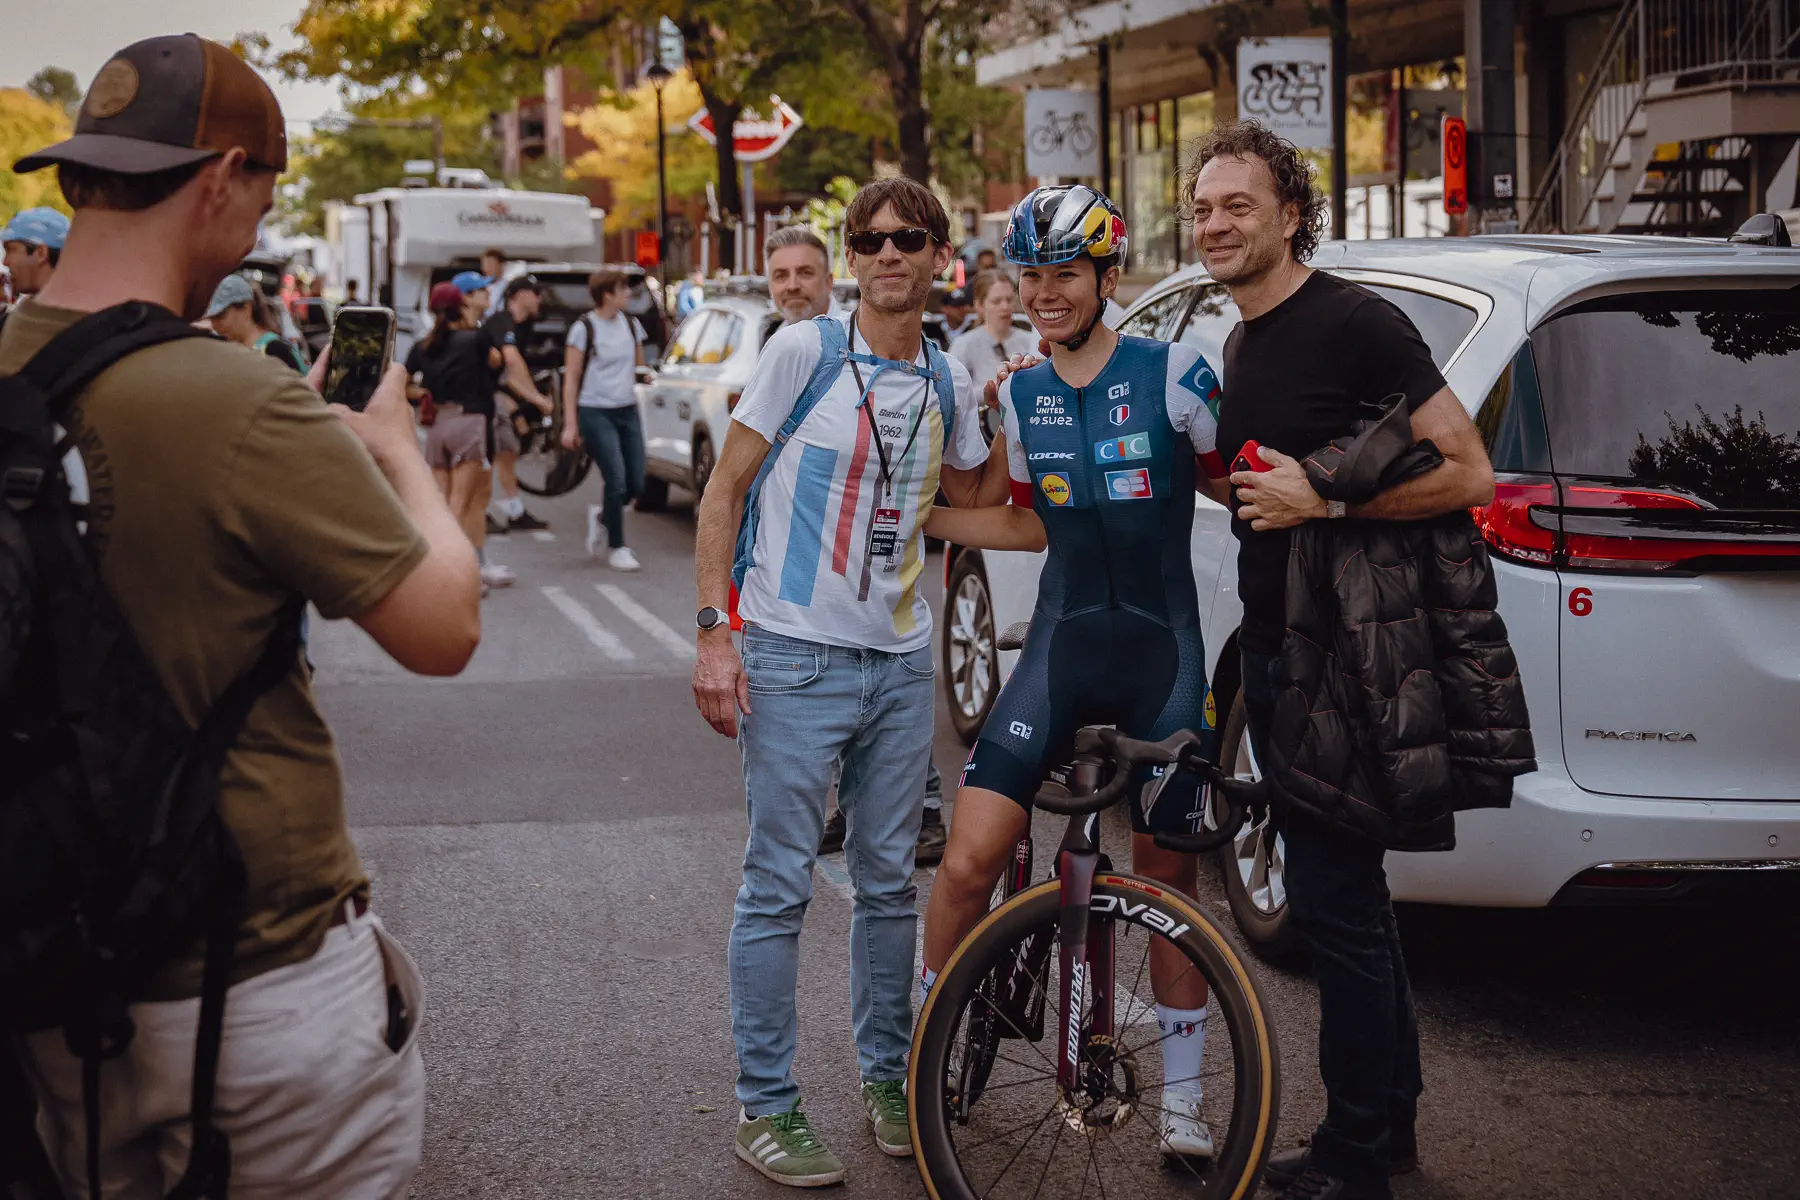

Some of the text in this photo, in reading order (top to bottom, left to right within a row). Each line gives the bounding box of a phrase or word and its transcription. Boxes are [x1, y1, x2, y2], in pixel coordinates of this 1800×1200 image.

[1036, 395, 1056, 407] FDJ
[878, 408, 908, 419] Santini
[879, 424, 903, 439] 1962
[1100, 437, 1146, 459] CIC
[1028, 452, 1076, 460] LOOK
[1568, 587, 1593, 617] 6
[1585, 728, 1697, 742] PACIFICA
[1123, 879, 1146, 890] COTTON
[1090, 894, 1190, 939] oval
[1067, 956, 1084, 1066] SPECIALIZED
